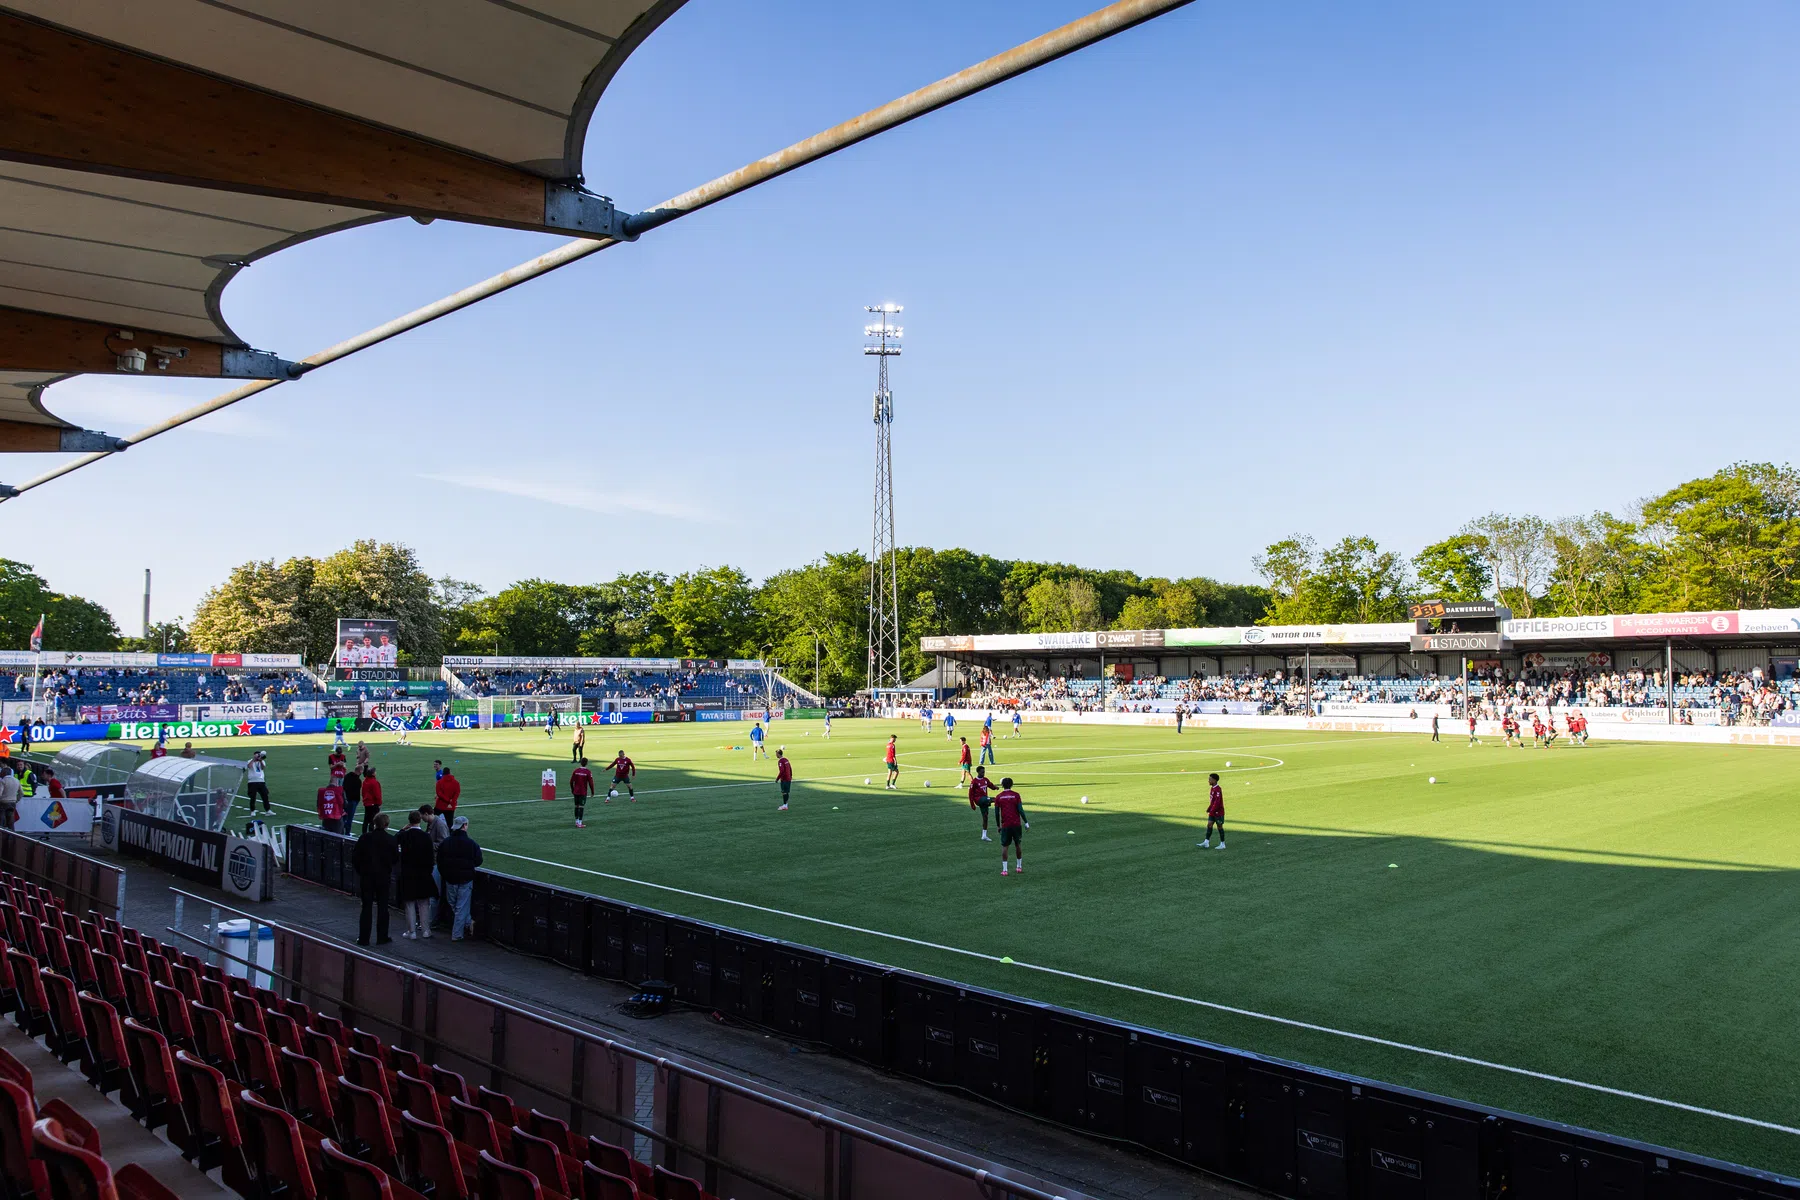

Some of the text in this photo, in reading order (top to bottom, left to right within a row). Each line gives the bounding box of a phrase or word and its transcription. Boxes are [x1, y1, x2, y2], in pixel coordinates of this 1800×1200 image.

[1665, 616, 1709, 625] WAERDER
[1508, 621, 1607, 633] OFFICE PROJECTS
[1635, 626, 1698, 634] ACCOUNTANTS
[1744, 624, 1789, 632] Zeehaven
[1038, 634, 1091, 646] SWANLAKE
[1107, 634, 1136, 643] ZWART
[1421, 636, 1487, 649] 711 STADION
[444, 657, 483, 665] BONTRUP
[686, 660, 696, 668] 711
[708, 660, 718, 668] 711
[1632, 658, 1639, 666] K
[343, 668, 400, 680] 711 STADION
[221, 705, 268, 714] TANGER
[654, 712, 664, 722] 711
[680, 712, 690, 722] 711
[720, 712, 737, 720] STEEL
[749, 711, 783, 719] NEDLOF
[121, 819, 219, 872] WWW.MPMOIL.NL
